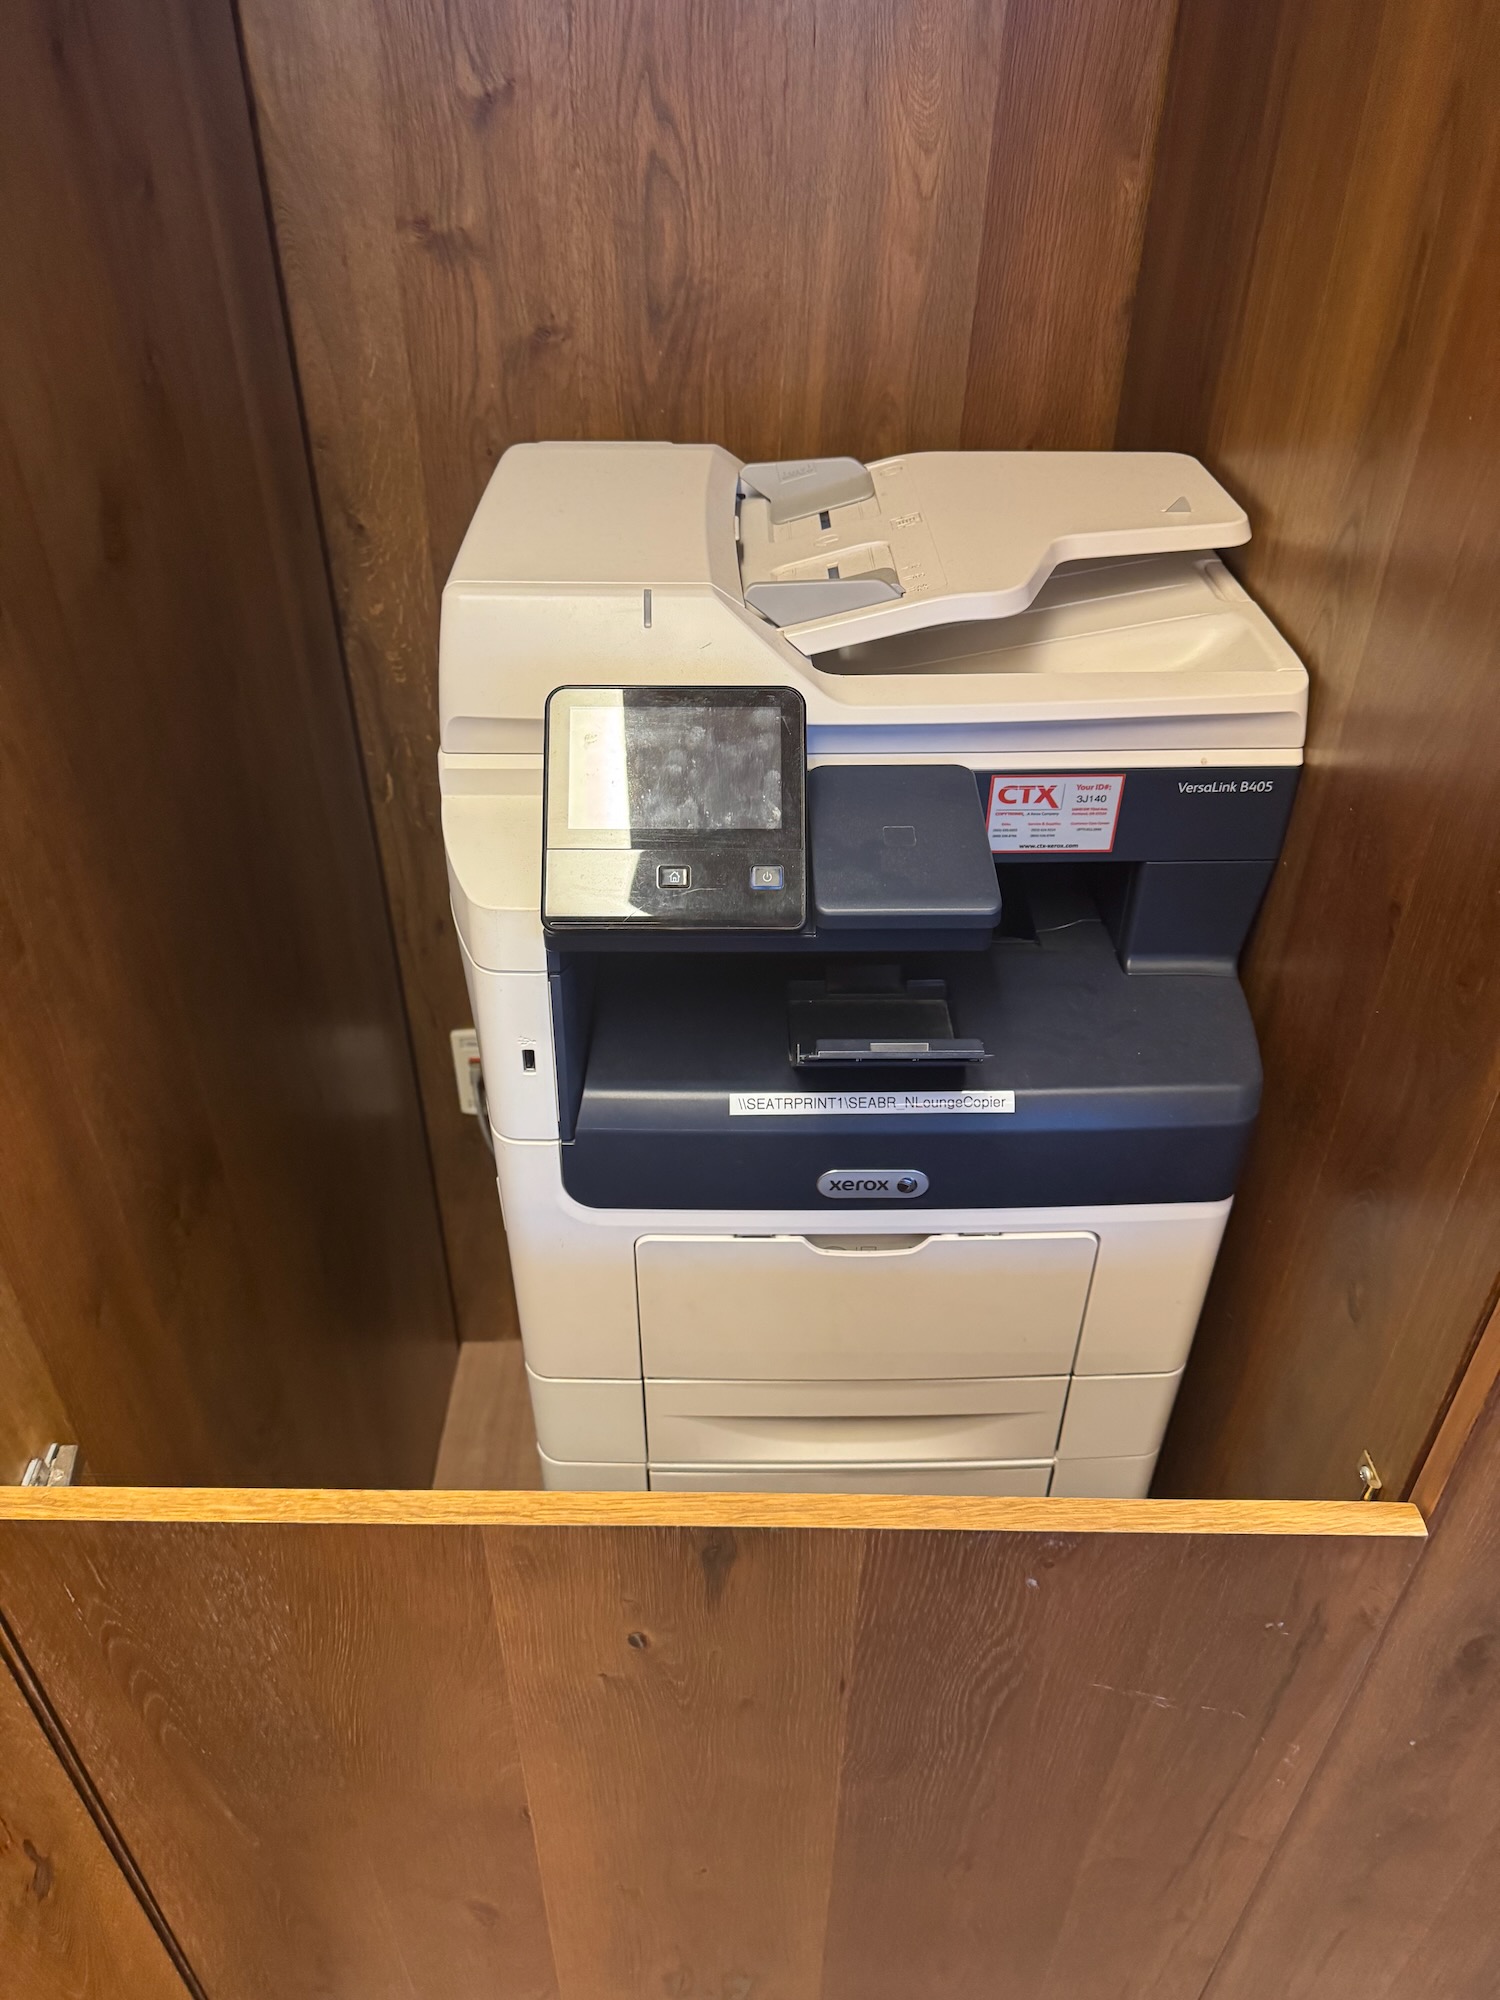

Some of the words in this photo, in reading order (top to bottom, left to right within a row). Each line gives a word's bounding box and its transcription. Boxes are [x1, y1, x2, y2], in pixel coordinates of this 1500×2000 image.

[1178, 781, 1238, 793] VersaLink
[1240, 781, 1273, 792] B405
[998, 785, 1059, 808] CTX
[1076, 795, 1107, 803] 3J140
[829, 1180, 889, 1191] xerox
